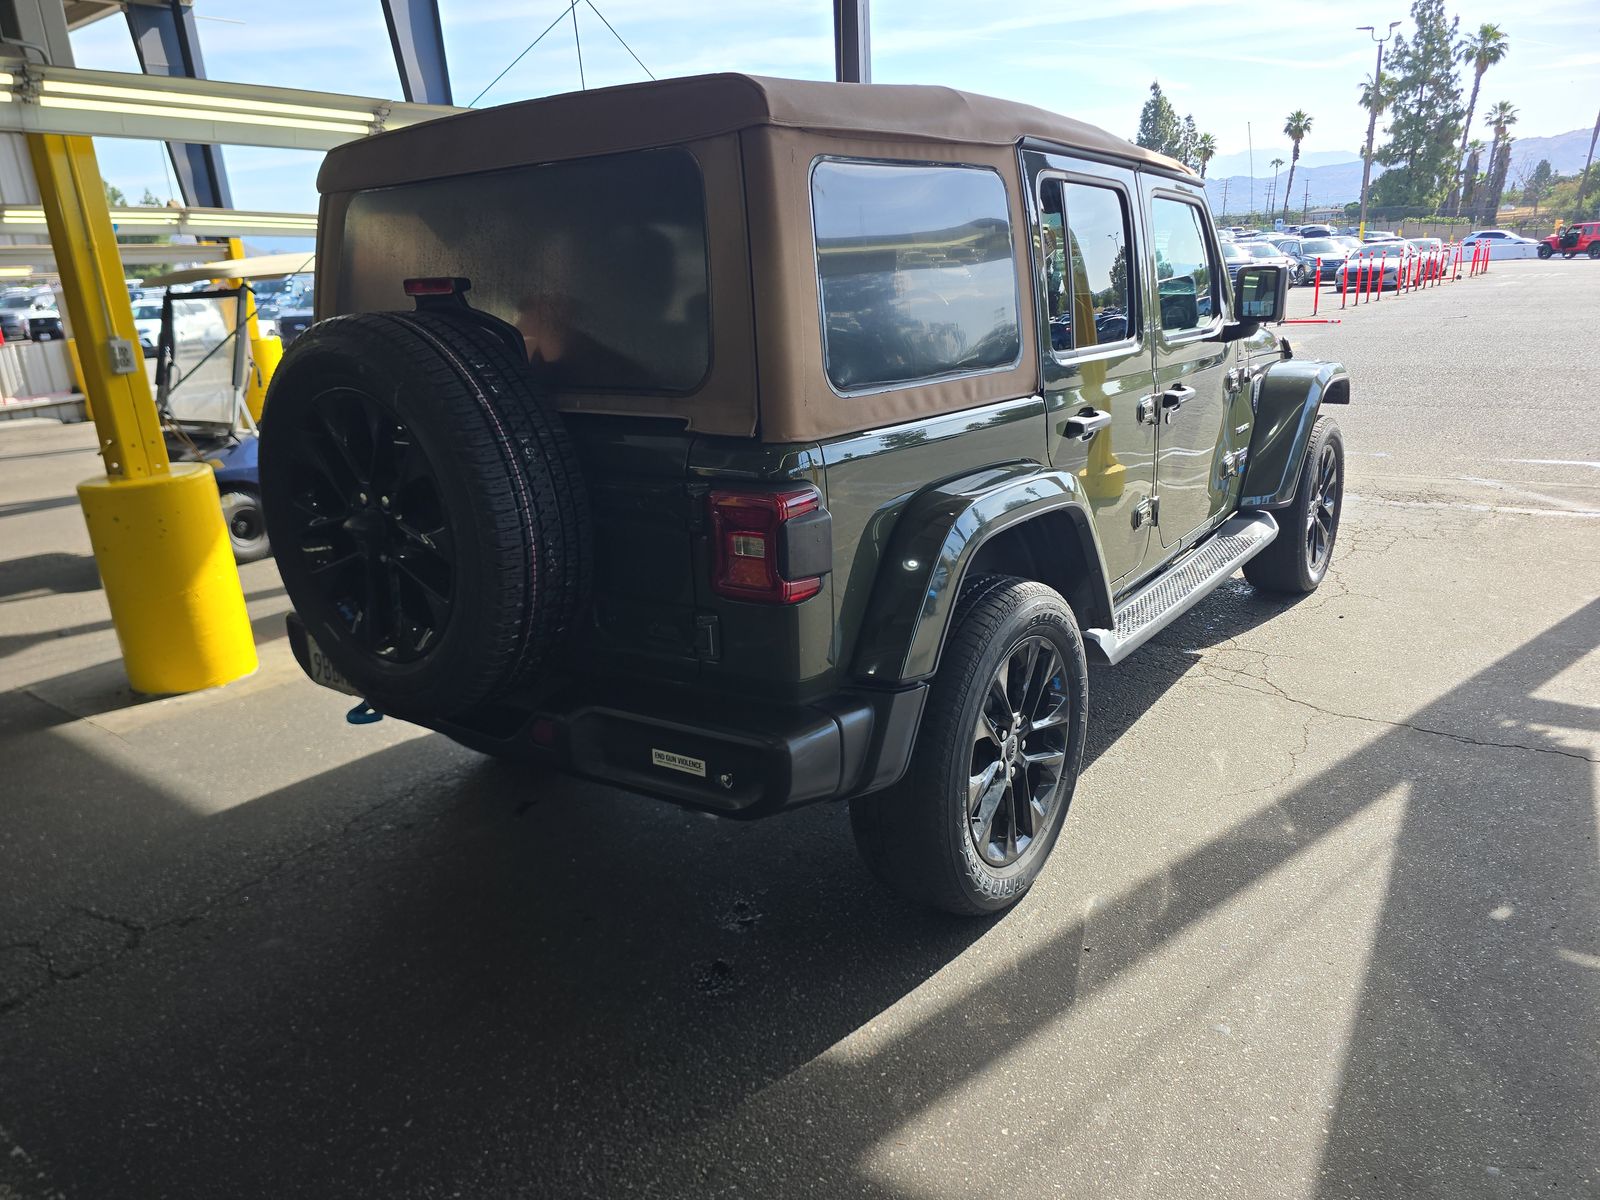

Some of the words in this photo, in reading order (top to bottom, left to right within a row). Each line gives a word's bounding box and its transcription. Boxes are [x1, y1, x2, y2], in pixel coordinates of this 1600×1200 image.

[654, 751, 665, 760] END
[666, 754, 677, 763] GUN
[677, 758, 702, 769] VIOLENCE
